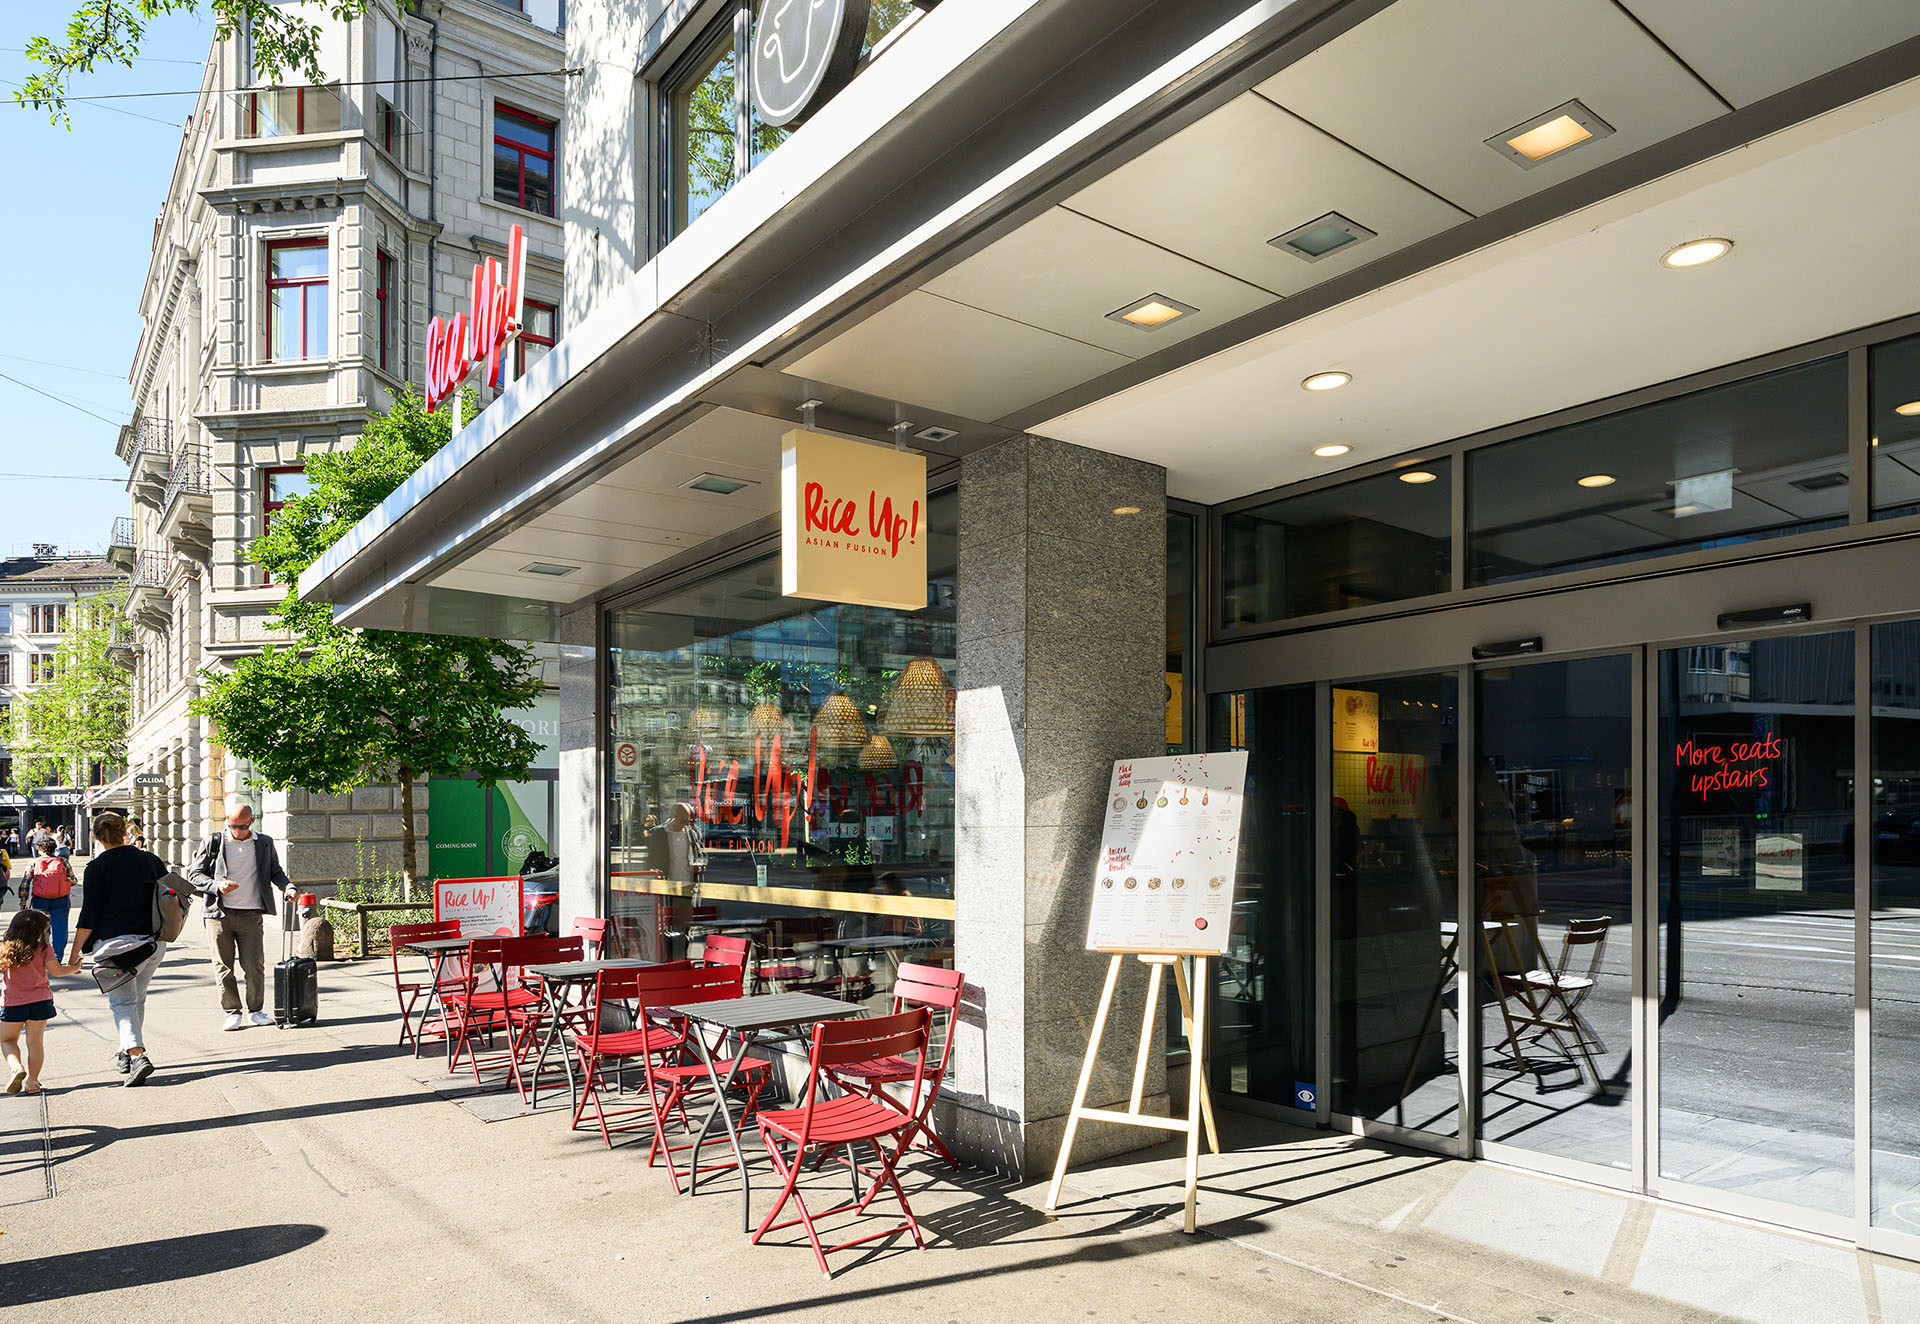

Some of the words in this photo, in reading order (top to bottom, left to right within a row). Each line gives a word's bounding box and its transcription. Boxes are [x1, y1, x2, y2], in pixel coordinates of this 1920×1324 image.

[804, 481, 860, 536] Rice
[868, 490, 919, 558] Up!
[806, 536, 839, 549] ASIAN
[846, 542, 887, 556] FUSION
[1676, 741, 1726, 766] More
[1731, 732, 1781, 762] seats
[754, 725, 817, 857] Up!
[1367, 755, 1396, 795] Rice
[1692, 763, 1768, 800] upstairs
[445, 890, 469, 909] Rice
[472, 888, 495, 911] Up!
